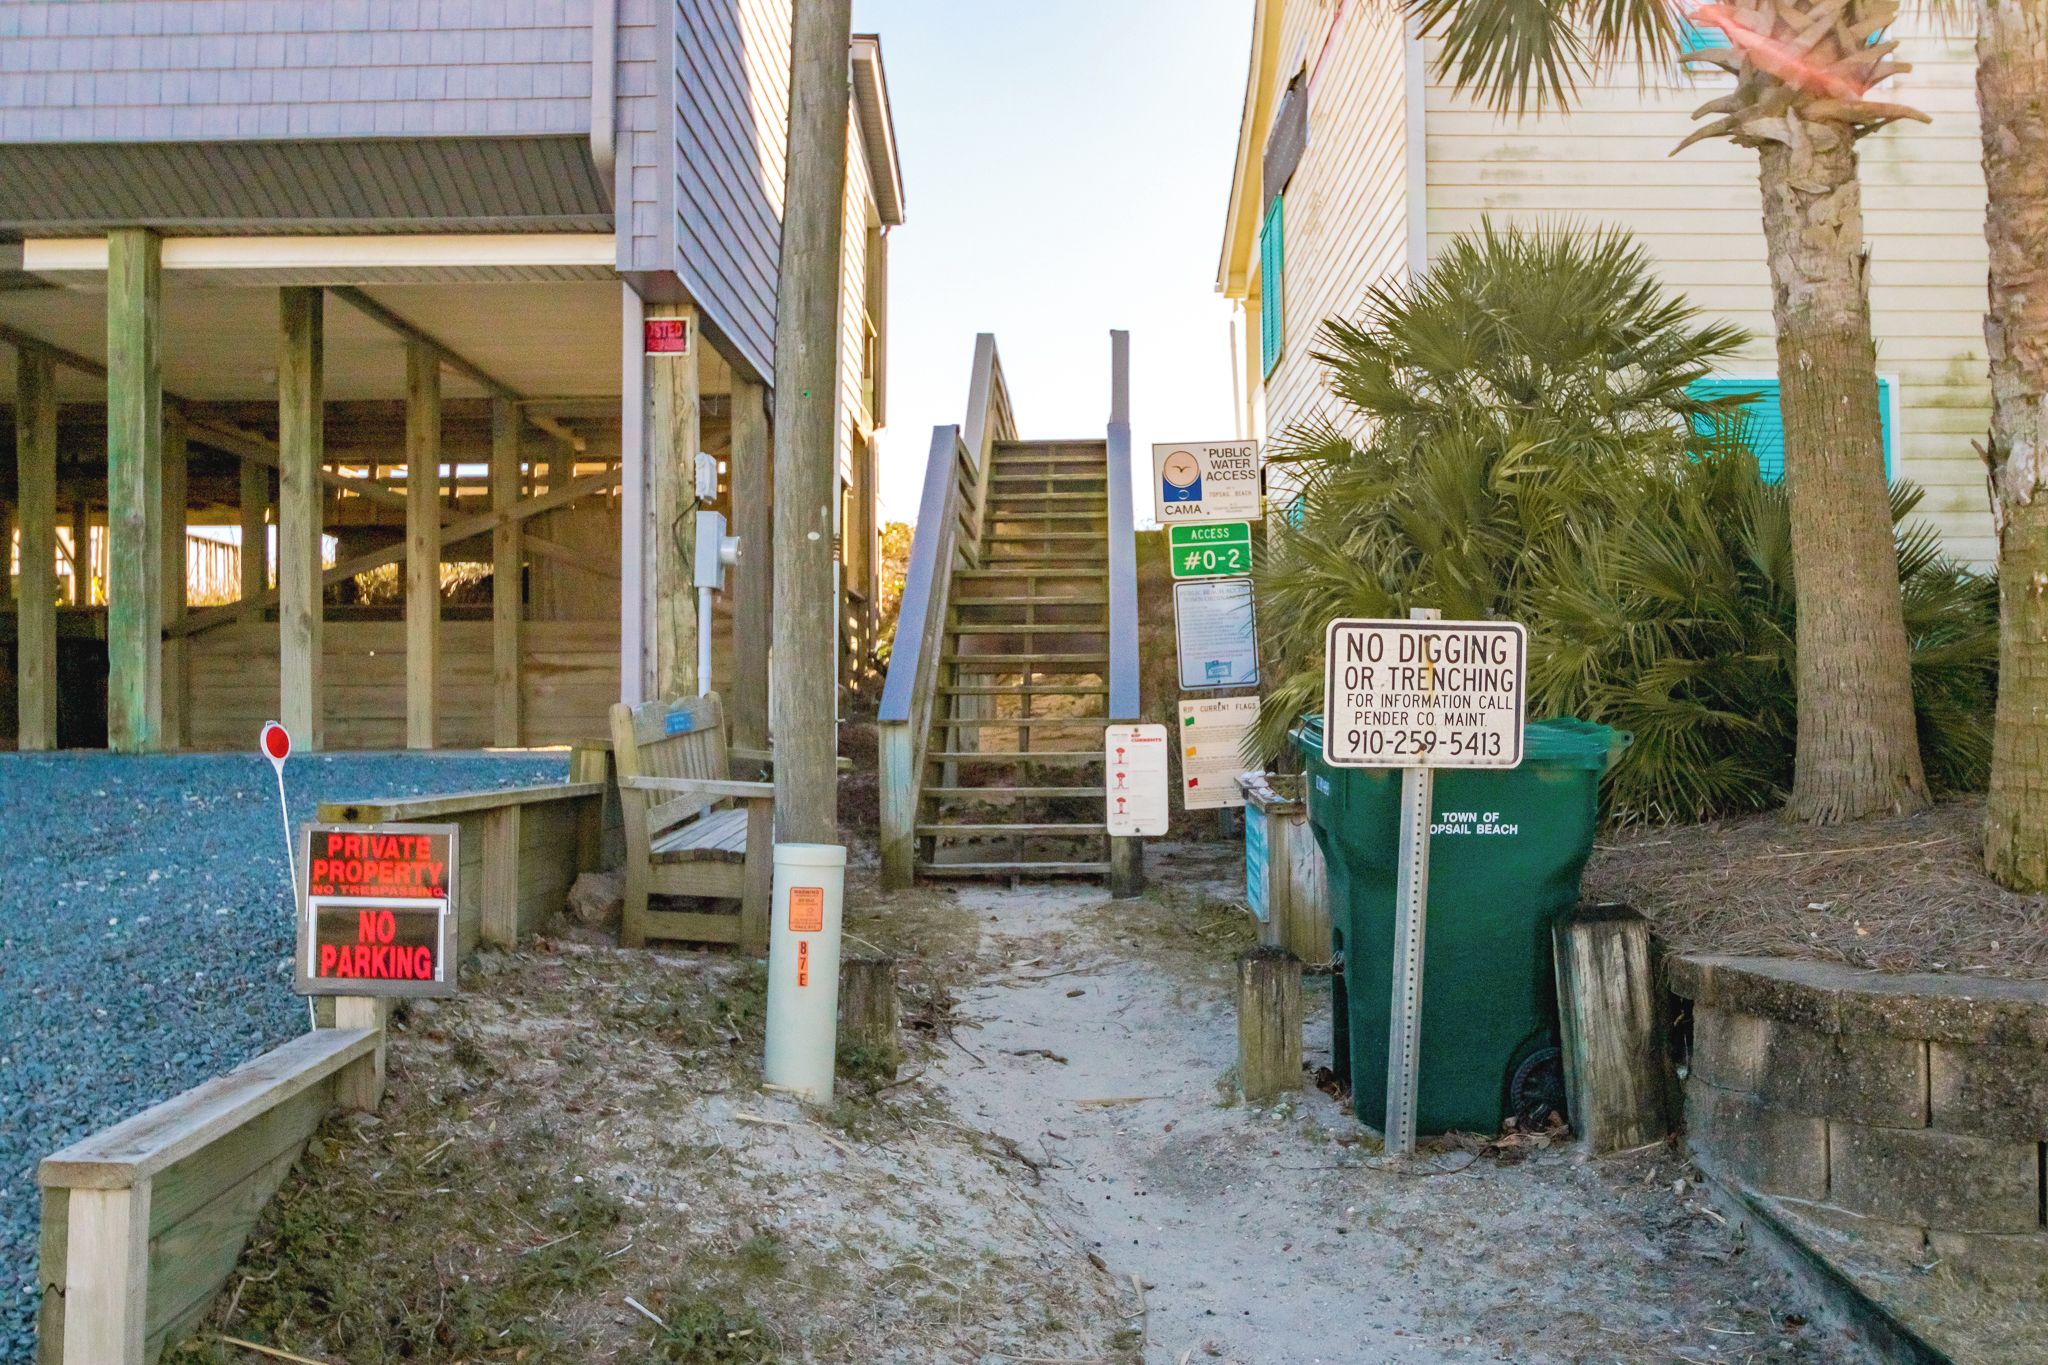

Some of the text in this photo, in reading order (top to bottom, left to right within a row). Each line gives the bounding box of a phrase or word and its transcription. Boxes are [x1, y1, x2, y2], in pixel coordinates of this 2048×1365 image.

[1209, 447, 1251, 458] PUBLIC
[1210, 459, 1251, 470] WATER
[1206, 469, 1256, 481] ACCESS
[1164, 504, 1202, 515] CAMA
[1191, 527, 1230, 539] ACCESS
[1183, 548, 1241, 570] #0-2
[1346, 632, 1507, 665] NO DIGGING
[1344, 666, 1514, 693] OR TRENCHING
[1200, 704, 1230, 712] CURRENT
[1235, 702, 1257, 710] FLAGS
[1347, 693, 1513, 710] FOR INFORMATION CALL
[1354, 711, 1487, 727] PENDER CO. MAINT.
[1347, 729, 1501, 756] 910-259-5413
[1441, 812, 1500, 822] TOWN OF
[1429, 824, 1518, 835] OPSAIL BEACH
[328, 834, 431, 859] PRIVATE
[312, 859, 443, 885] PROPERTY
[312, 885, 335, 895] NO
[358, 910, 396, 943] NO
[320, 944, 432, 980] PARKING
